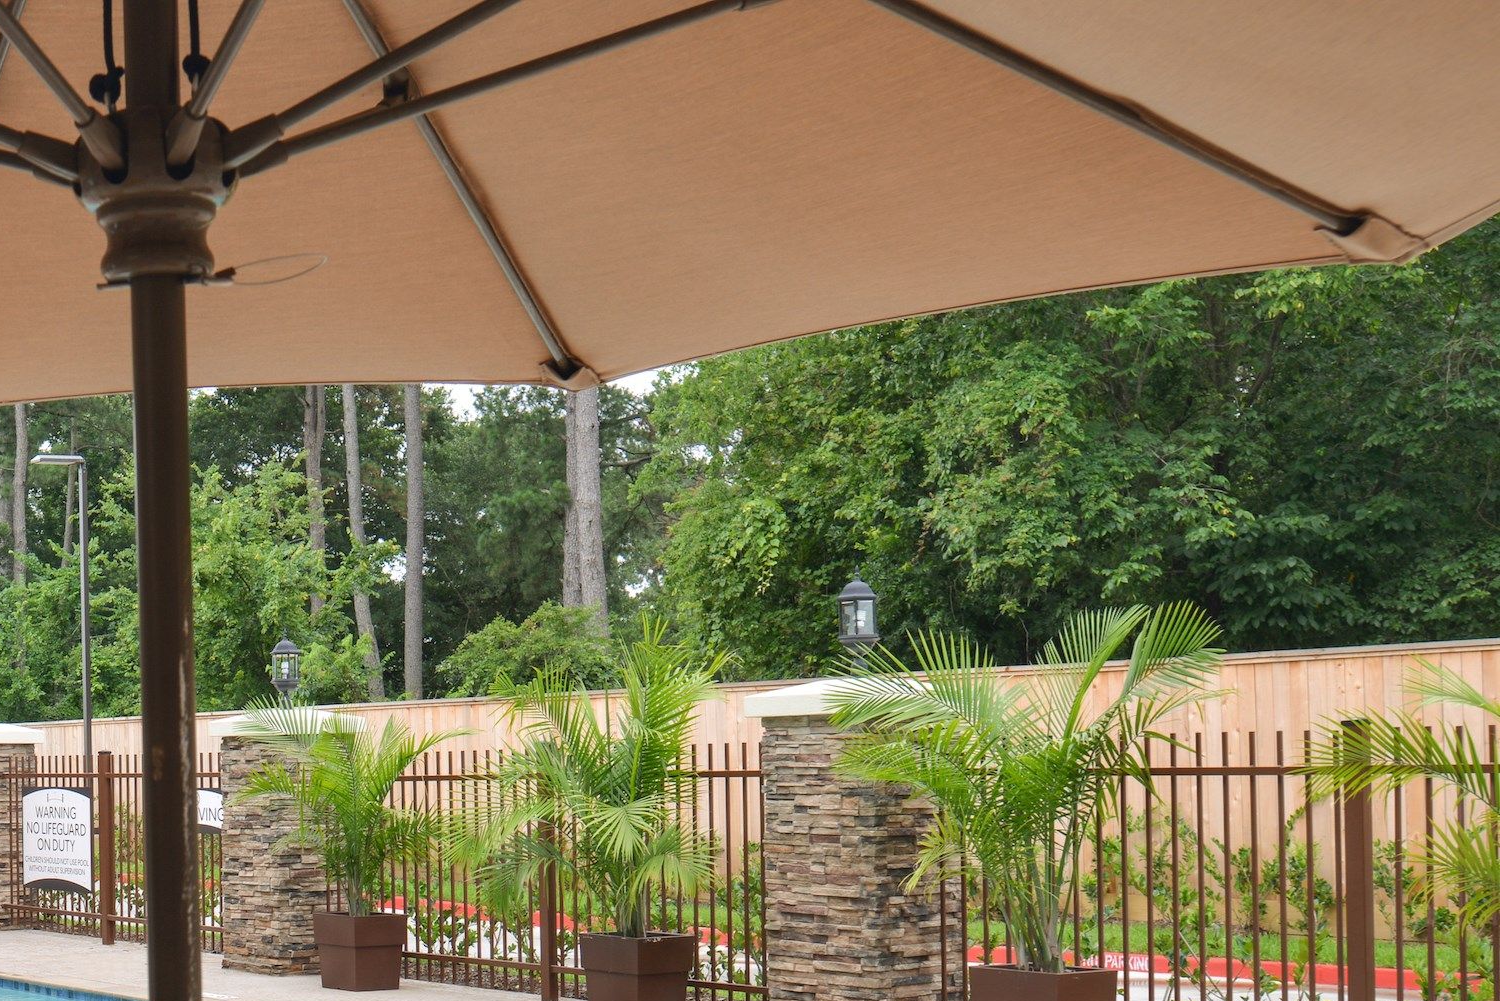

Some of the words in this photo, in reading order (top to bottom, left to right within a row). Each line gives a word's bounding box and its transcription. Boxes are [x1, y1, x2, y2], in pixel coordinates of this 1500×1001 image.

[35, 806, 77, 820] WARNING
[198, 807, 224, 821] VING
[26, 821, 40, 834] NO
[41, 822, 87, 836] LIFEGUARD
[36, 838, 50, 850] ON
[52, 839, 75, 852] DUTY
[25, 855, 43, 863] CHILDREN
[43, 856, 60, 865] SHOULD
[70, 858, 78, 866] USE
[78, 859, 89, 867] POOL
[47, 866, 59, 874] ADULT
[59, 867, 86, 875] SUPERVISION
